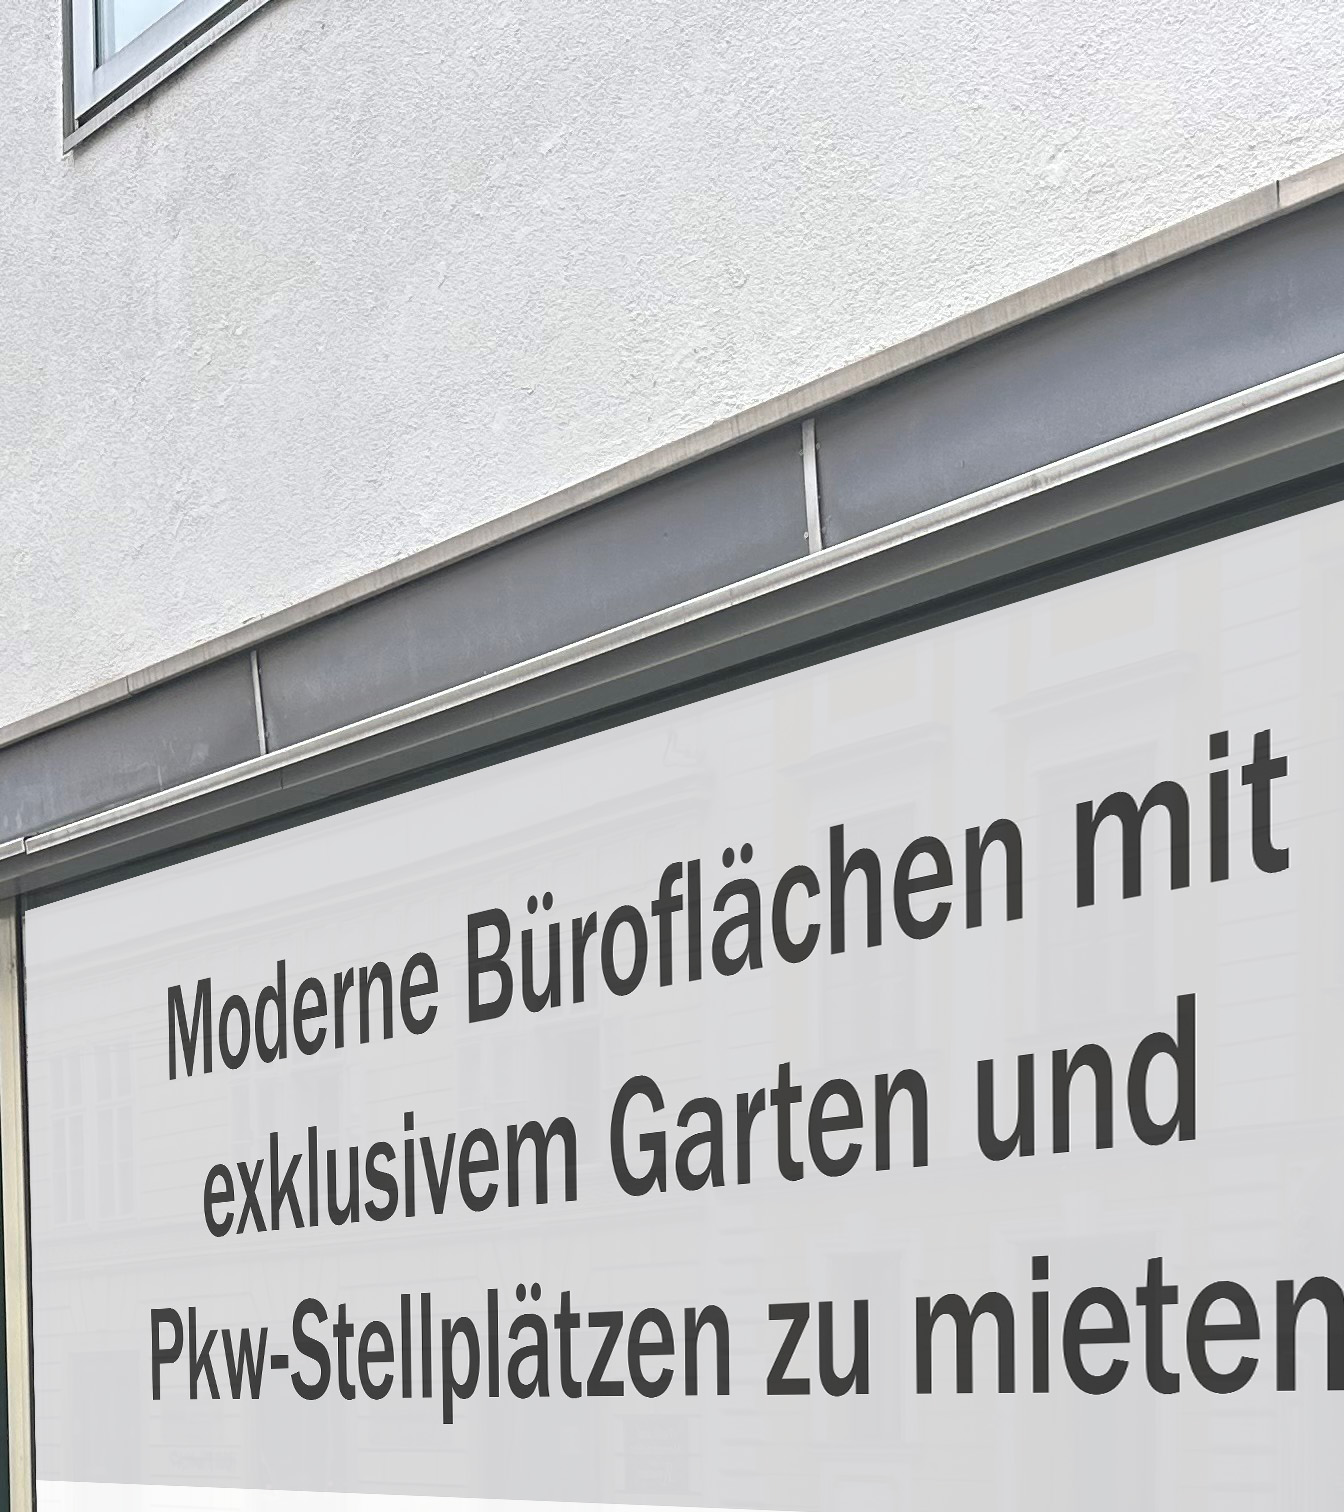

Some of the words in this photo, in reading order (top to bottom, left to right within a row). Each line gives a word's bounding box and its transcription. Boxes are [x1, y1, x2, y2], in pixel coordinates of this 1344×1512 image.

[168, 952, 440, 1080] Moderne
[467, 819, 1024, 1024] Büroflächen
[1076, 728, 1291, 908] mit
[203, 1111, 578, 1238] exklusivem
[610, 1062, 929, 1197] Garten
[977, 993, 1197, 1162] und
[150, 1283, 731, 1425] Pkw-Stellplätzen
[766, 1299, 870, 1398] zu
